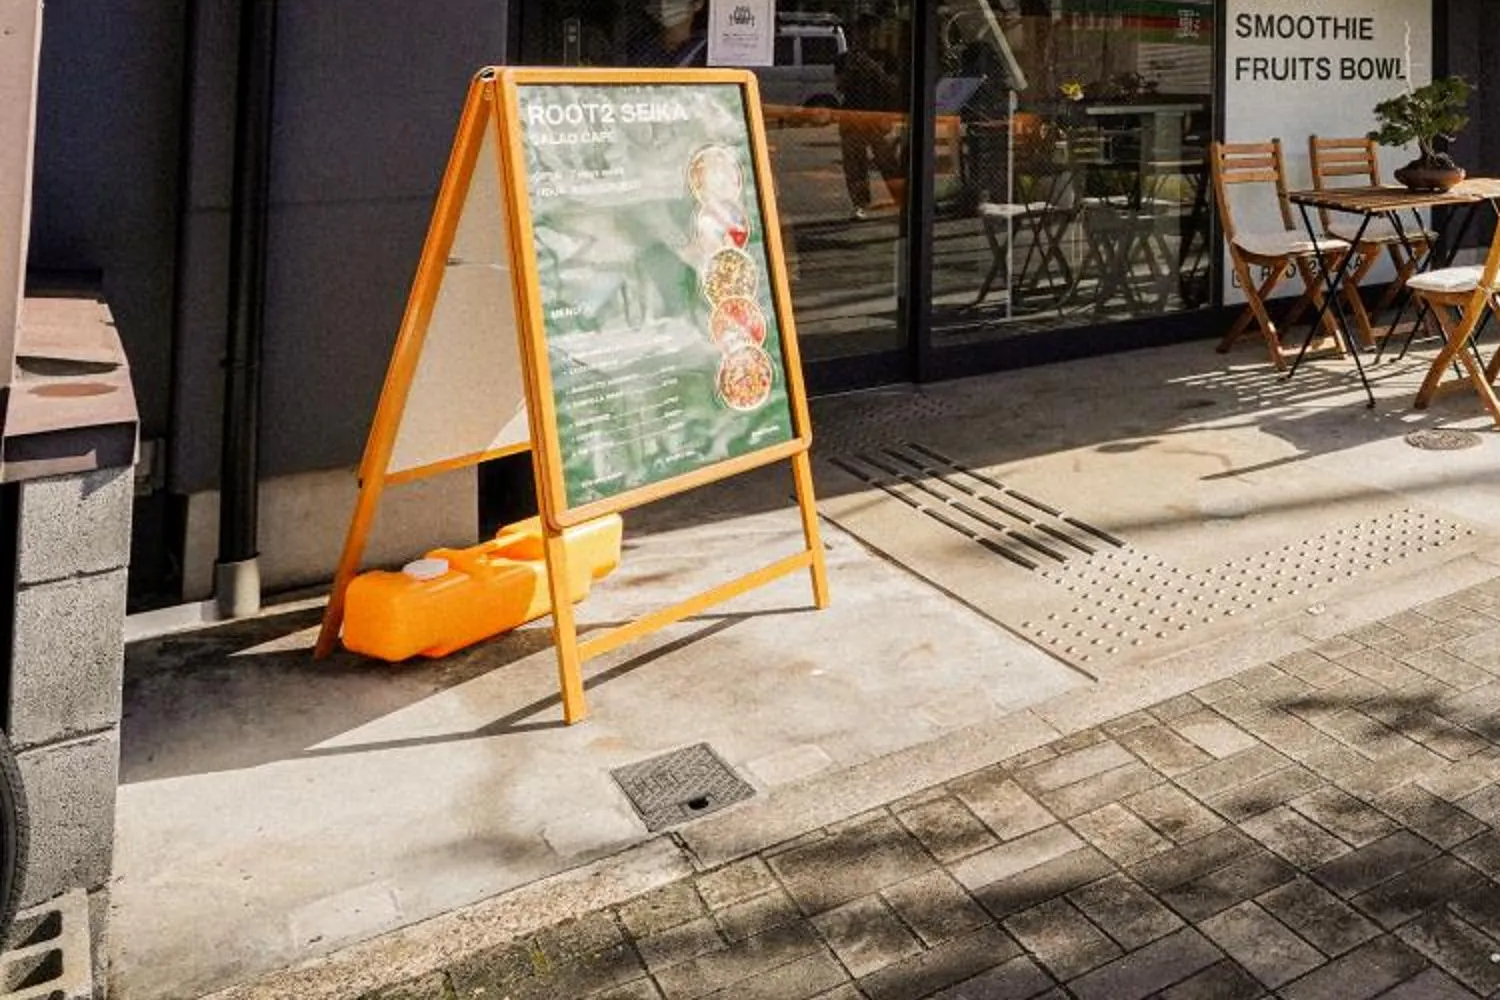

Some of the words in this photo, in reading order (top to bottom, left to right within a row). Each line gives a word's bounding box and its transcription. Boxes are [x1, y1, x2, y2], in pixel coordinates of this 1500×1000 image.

[1235, 13, 1374, 41] SMOOTHIE
[1235, 57, 1331, 81] FRUITS
[1340, 57, 1407, 80] BOWL
[528, 103, 615, 126] ROOT2
[621, 102, 690, 123] SEIKA
